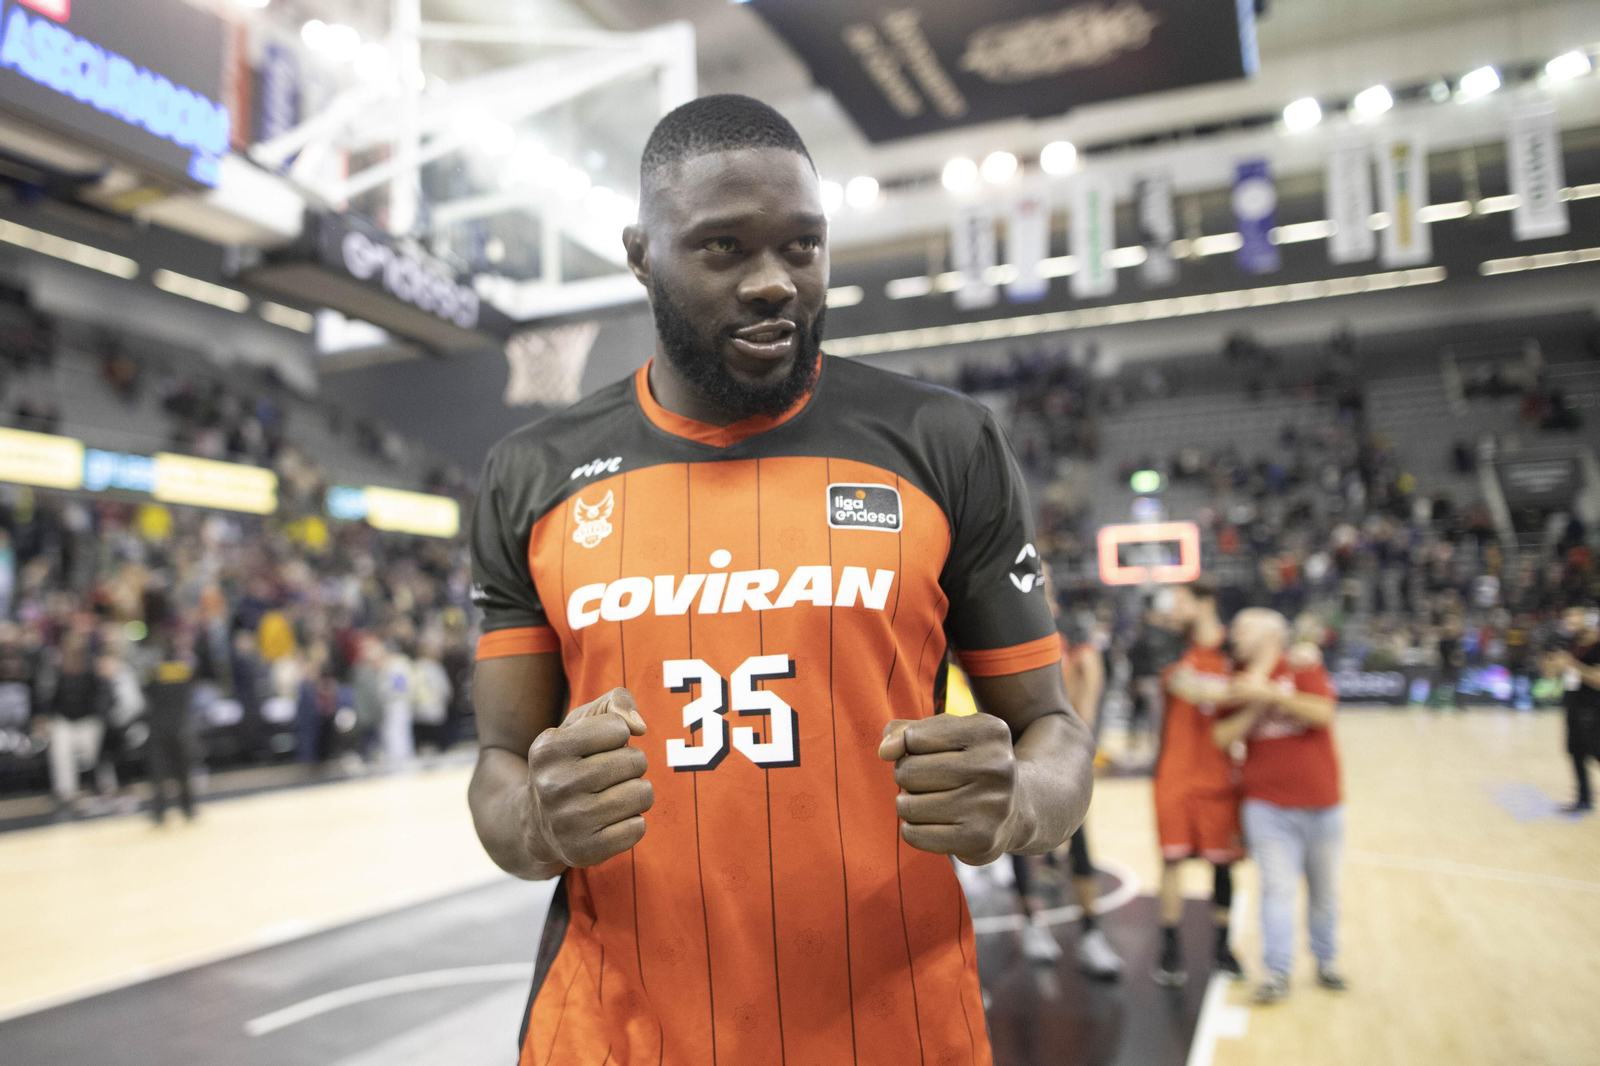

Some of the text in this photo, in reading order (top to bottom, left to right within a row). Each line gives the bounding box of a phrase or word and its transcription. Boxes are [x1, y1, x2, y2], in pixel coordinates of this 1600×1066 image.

[835, 495, 864, 511] liga
[835, 509, 897, 525] endesa
[663, 654, 801, 772] 35
